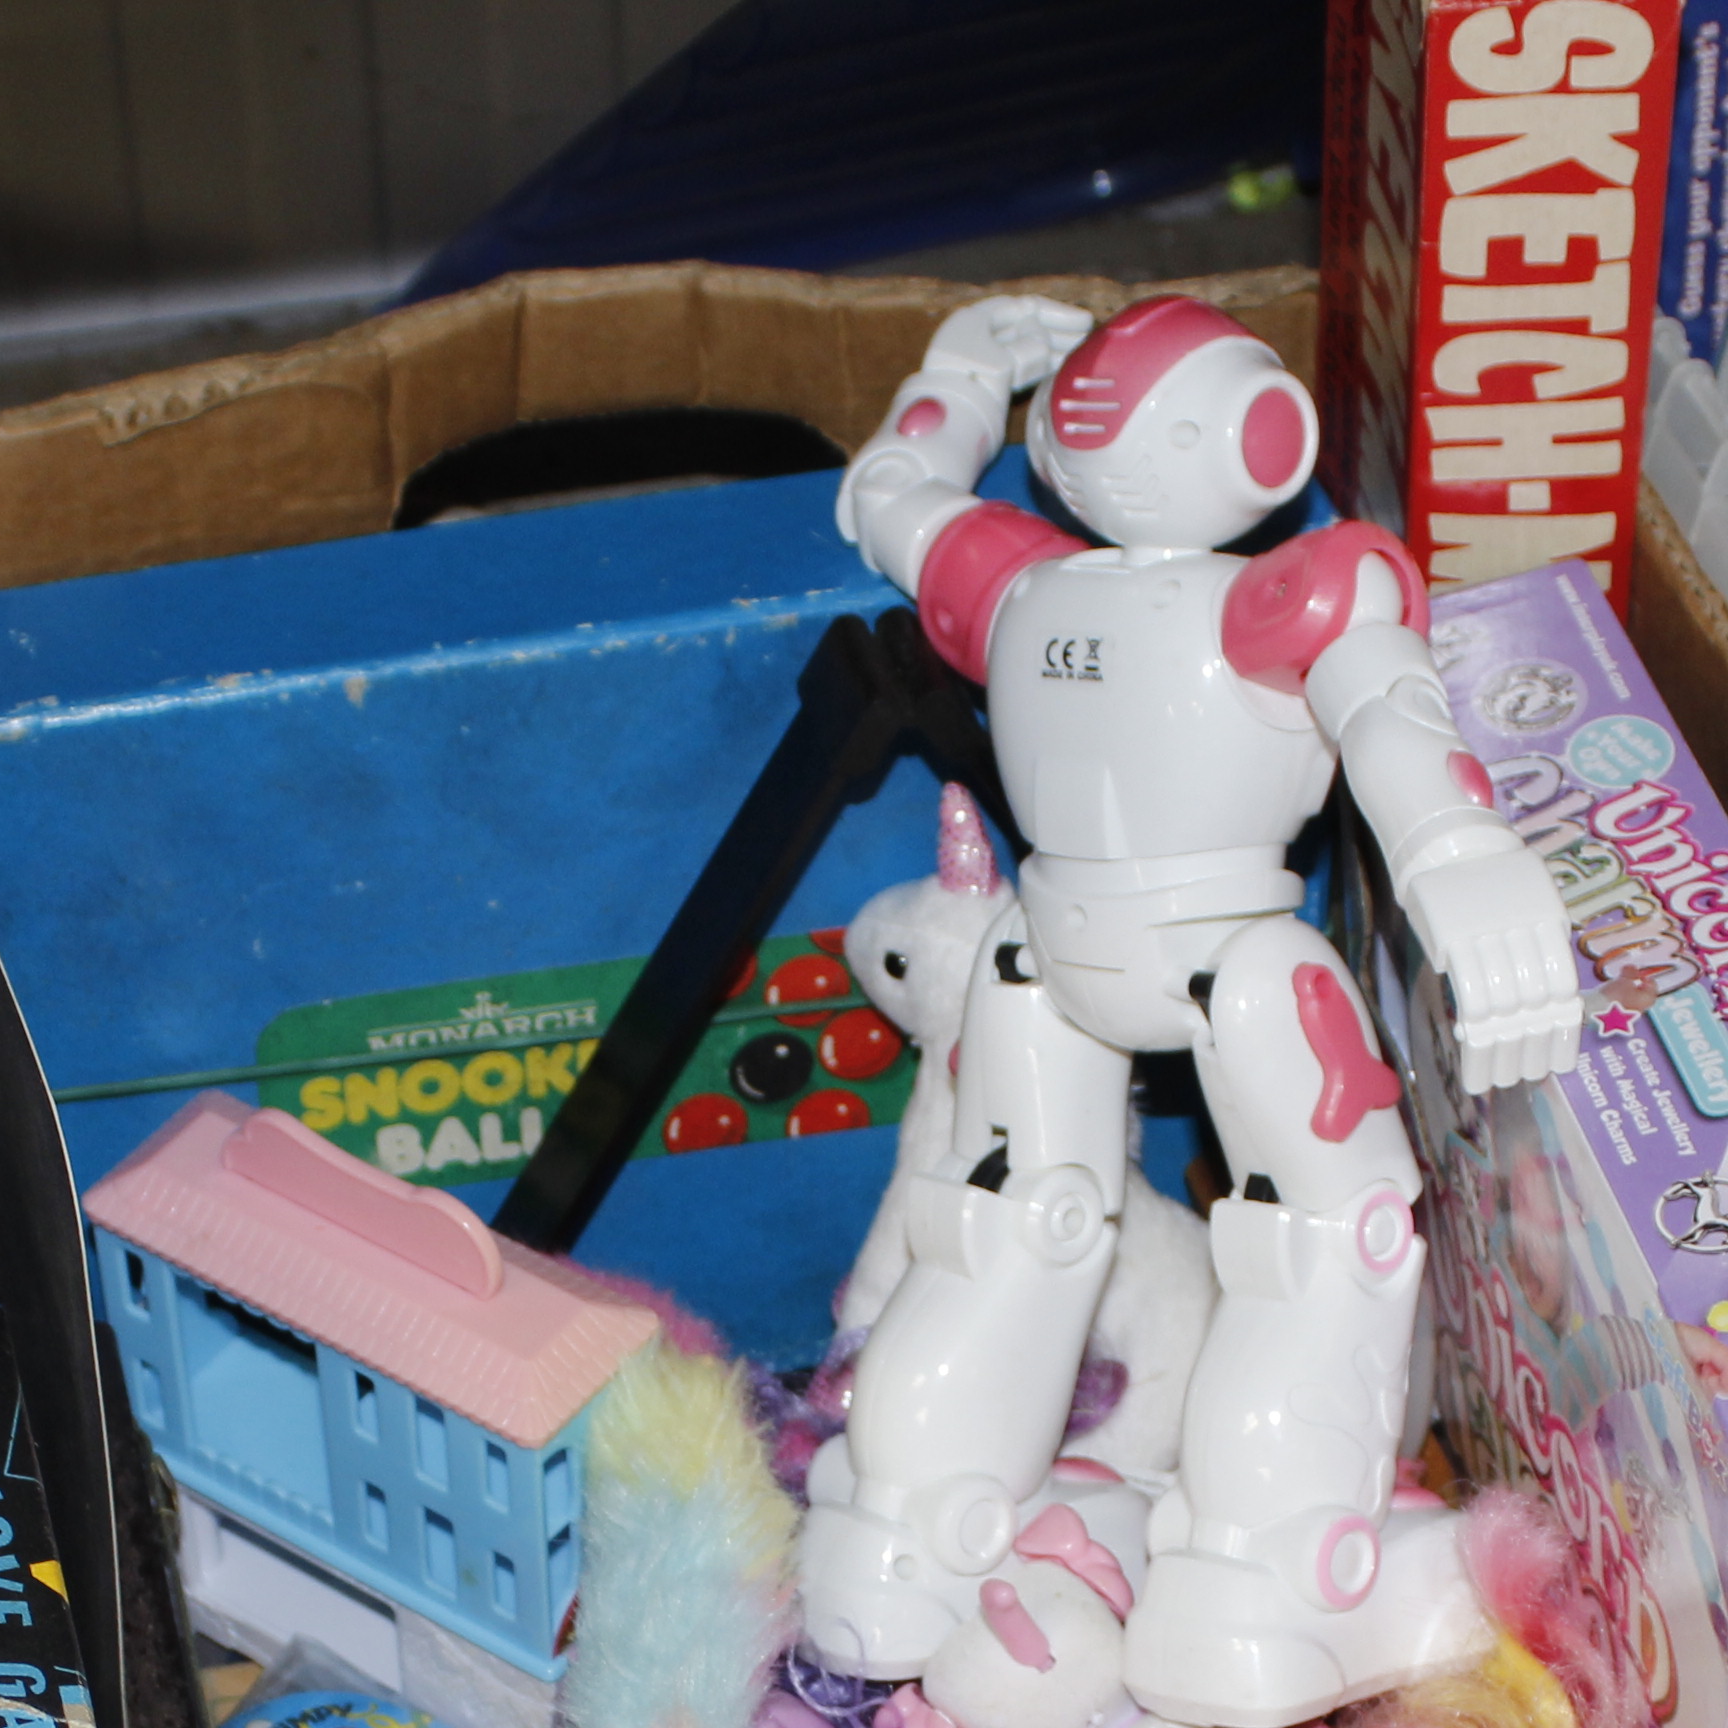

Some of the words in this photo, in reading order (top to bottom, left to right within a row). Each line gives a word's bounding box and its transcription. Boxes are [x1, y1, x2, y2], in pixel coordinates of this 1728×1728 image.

[1687, 178, 1716, 238] your
[1425, 0, 1655, 596] SKETCH-M
[1677, 241, 1707, 317] Guess
[1488, 753, 1704, 995] Charm
[368, 1006, 597, 1050] MONARCH
[1576, 1052, 1610, 1105] Unicorn
[1602, 1103, 1638, 1166] Charms
[1599, 1045, 1622, 1073] with
[1613, 1073, 1657, 1137] Magical
[1627, 1037, 1661, 1087] Create
[1651, 1086, 1698, 1157] Jewellery
